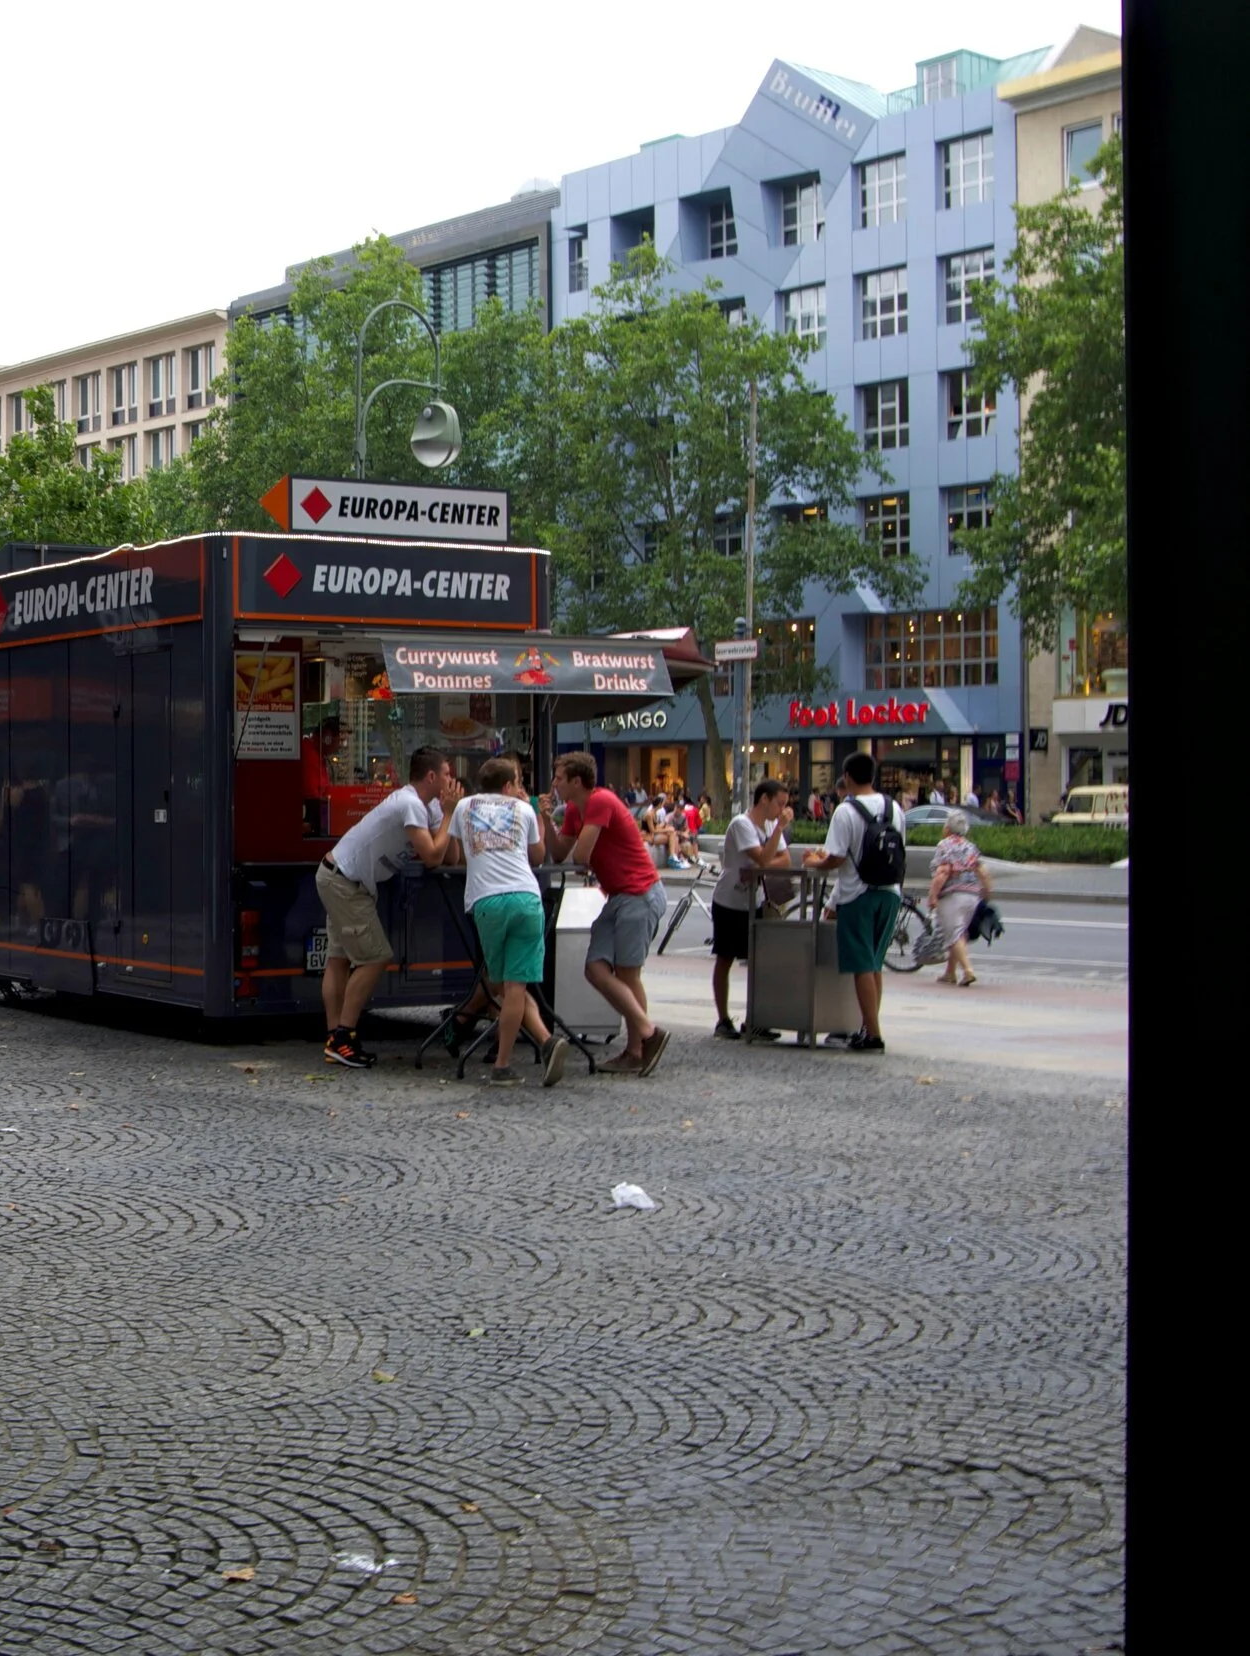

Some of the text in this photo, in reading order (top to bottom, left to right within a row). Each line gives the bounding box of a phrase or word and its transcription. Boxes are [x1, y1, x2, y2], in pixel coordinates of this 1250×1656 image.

[338, 495, 500, 527] EUROPA-CENTER
[312, 564, 511, 601] EUROPA-CENTER
[14, 566, 154, 626] EUROPA-CENTER
[395, 648, 498, 669] Currywurst
[572, 651, 655, 670] Bratwurst
[413, 671, 492, 689] Pommes
[594, 672, 647, 691] Drinks
[789, 696, 931, 728] Foot Locker
[1099, 703, 1128, 727] JD
